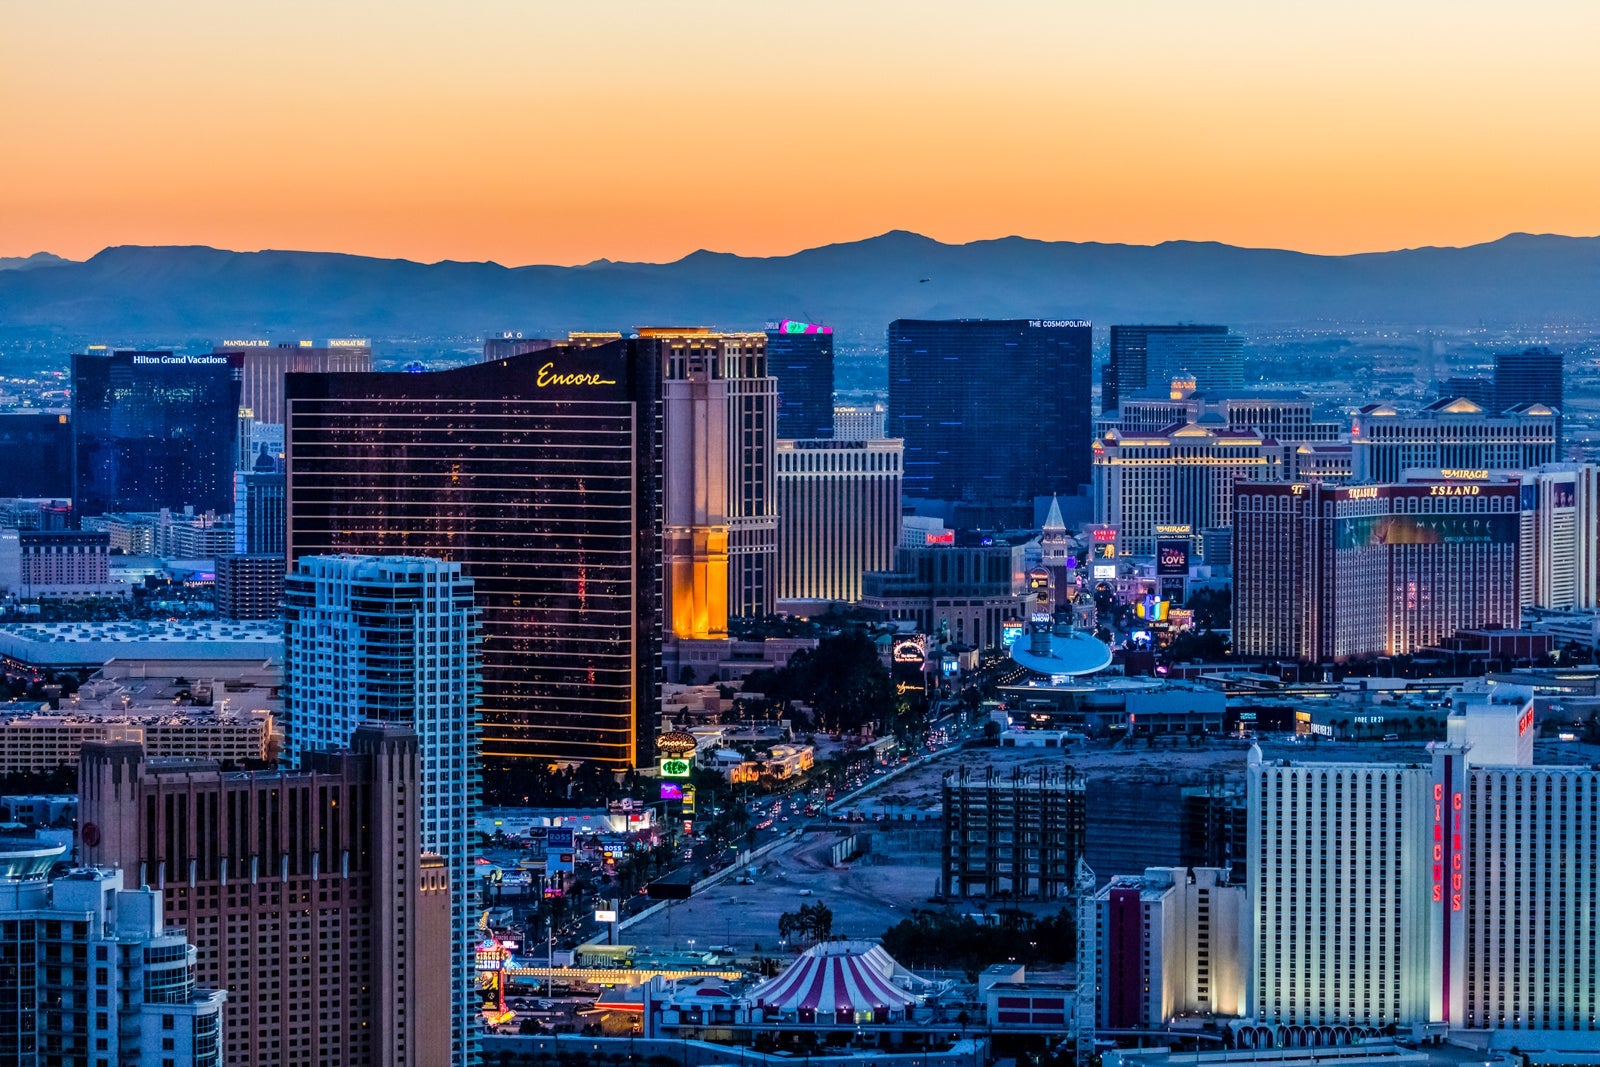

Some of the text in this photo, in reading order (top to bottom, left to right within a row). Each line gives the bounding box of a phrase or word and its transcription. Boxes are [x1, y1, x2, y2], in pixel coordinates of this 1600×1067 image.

[133, 356, 227, 364] Hilton Grand Vacations
[536, 362, 616, 388] Encore
[797, 440, 864, 450] VENETIAN
[1450, 469, 1488, 479] MIRAGE
[1348, 486, 1480, 499] TREASURE ISLAND
[1162, 556, 1185, 564] LOVE
[1310, 724, 1332, 736] FOREVER 21
[658, 736, 695, 748] Encore
[1432, 784, 1442, 902] CIRCUS
[1452, 793, 1462, 911] CIRCUS
[476, 952, 500, 960] CIRCUS
